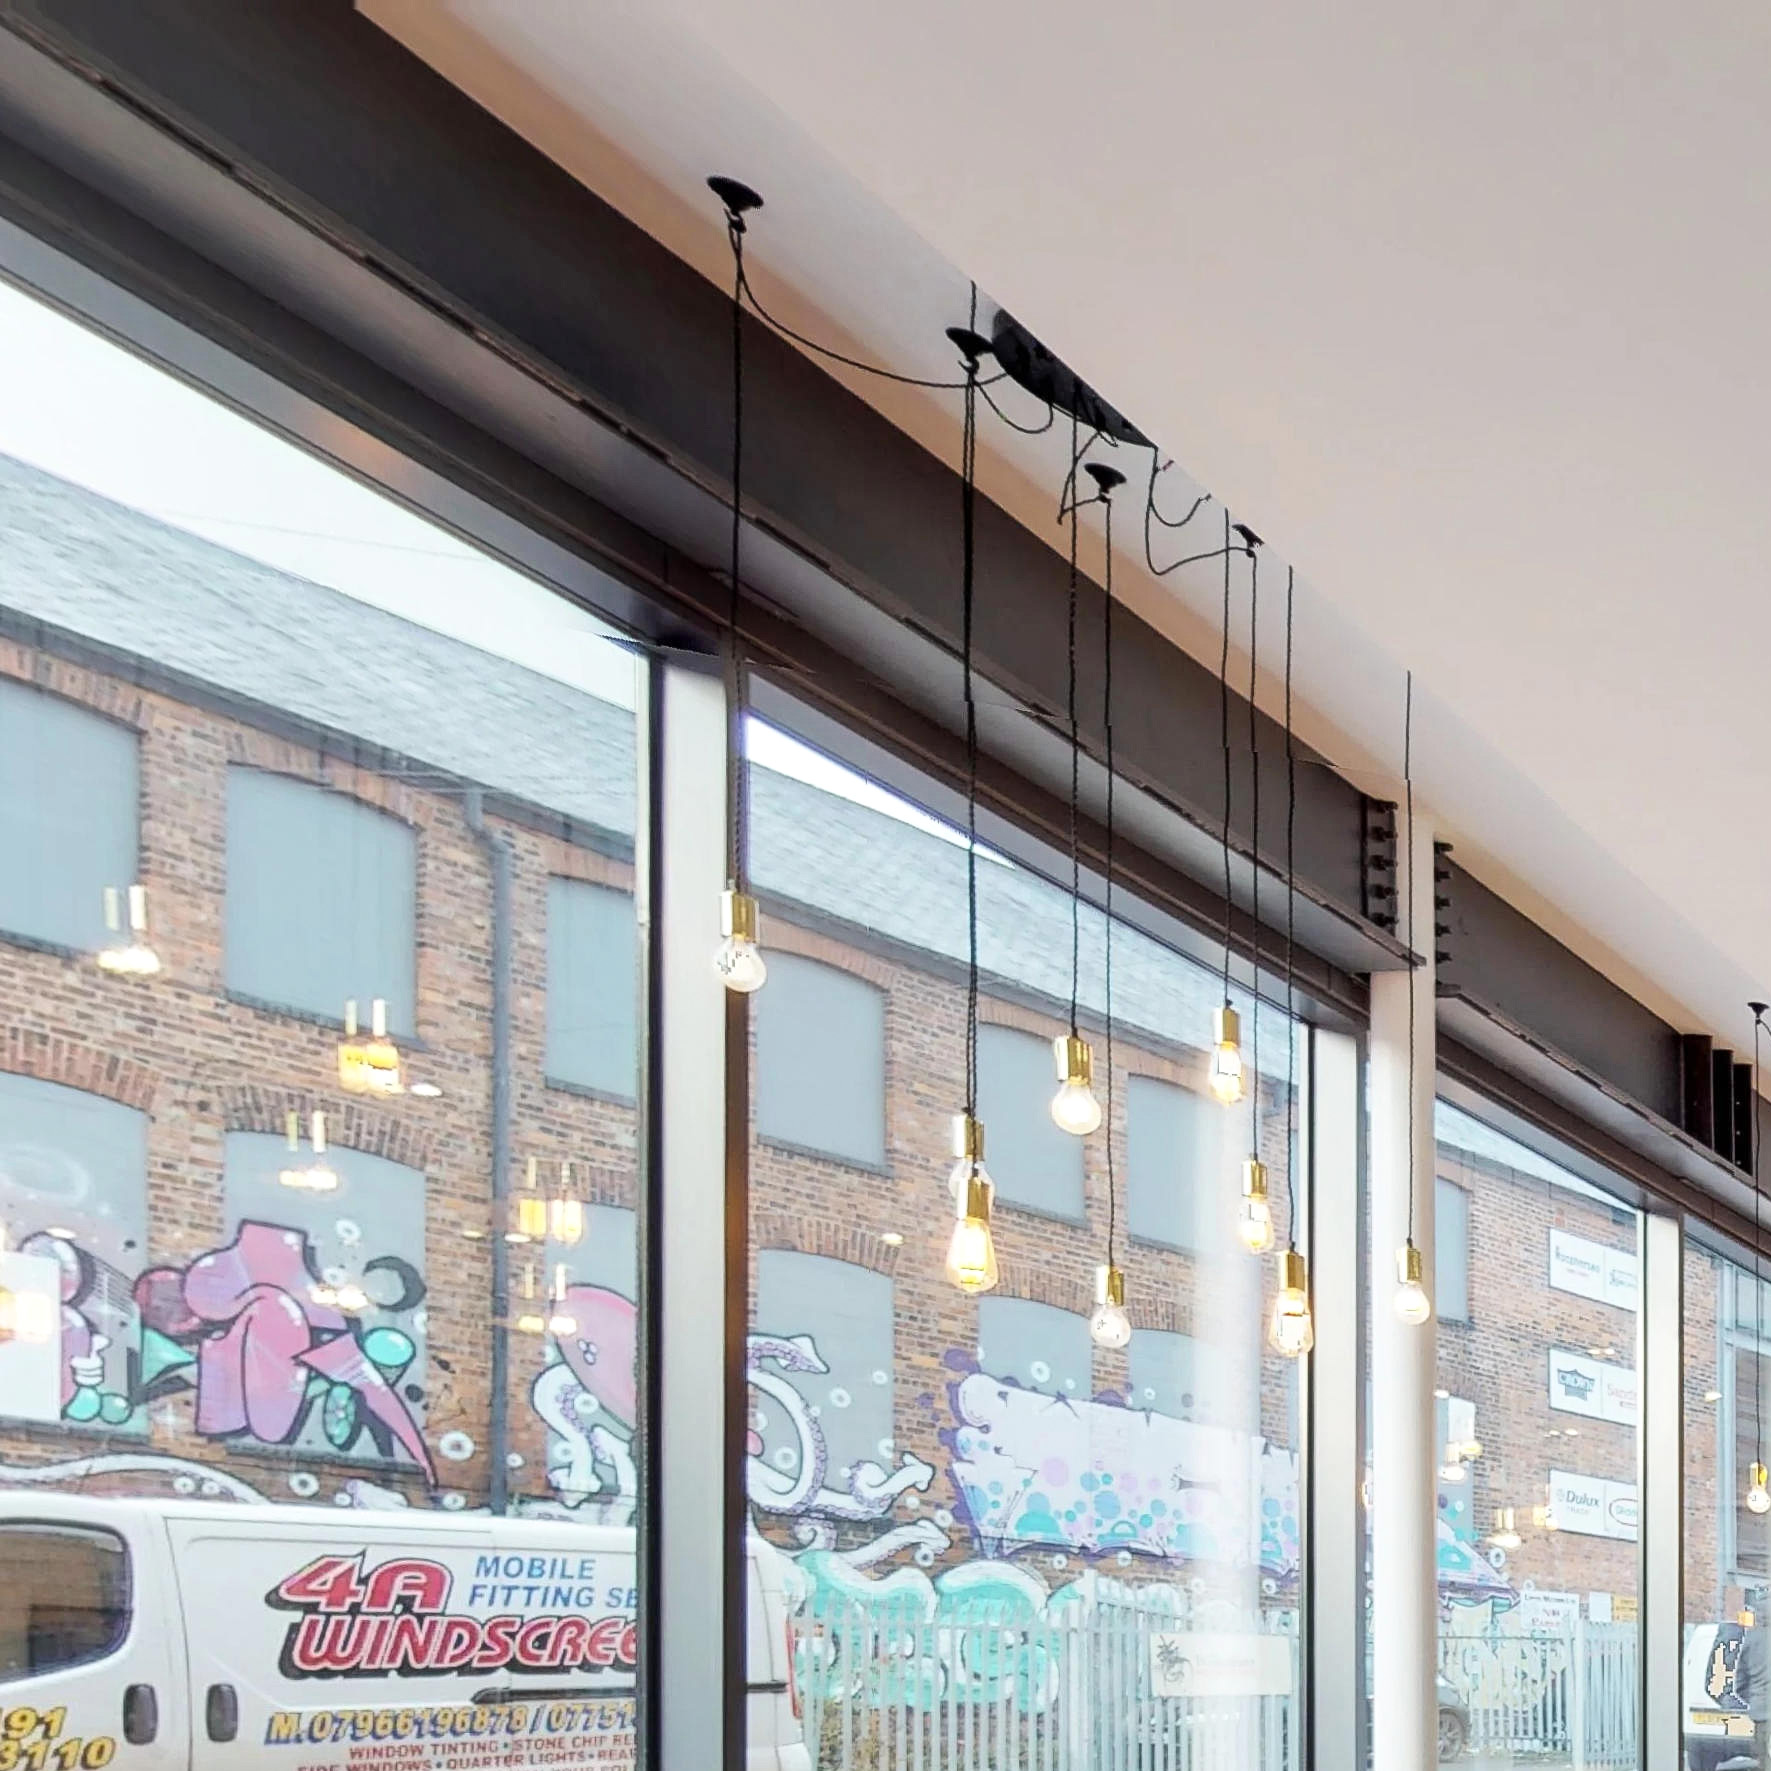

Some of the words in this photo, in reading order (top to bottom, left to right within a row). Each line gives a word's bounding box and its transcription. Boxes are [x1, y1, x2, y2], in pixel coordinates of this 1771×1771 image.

[1566, 1489, 1600, 1507] Dulux
[475, 1555, 597, 1581] MOBILE
[270, 1552, 452, 1613] 4A
[468, 1583, 596, 1609] FITTING
[350, 1744, 424, 1760] WINDOW
[431, 1741, 499, 1756] TINTING
[511, 1736, 566, 1751] STONE
[571, 1735, 610, 1749] CHIP
[612, 1733, 637, 1747] RE
[446, 1753, 524, 1771] QUARTER
[529, 1750, 585, 1766] LIGHTS
